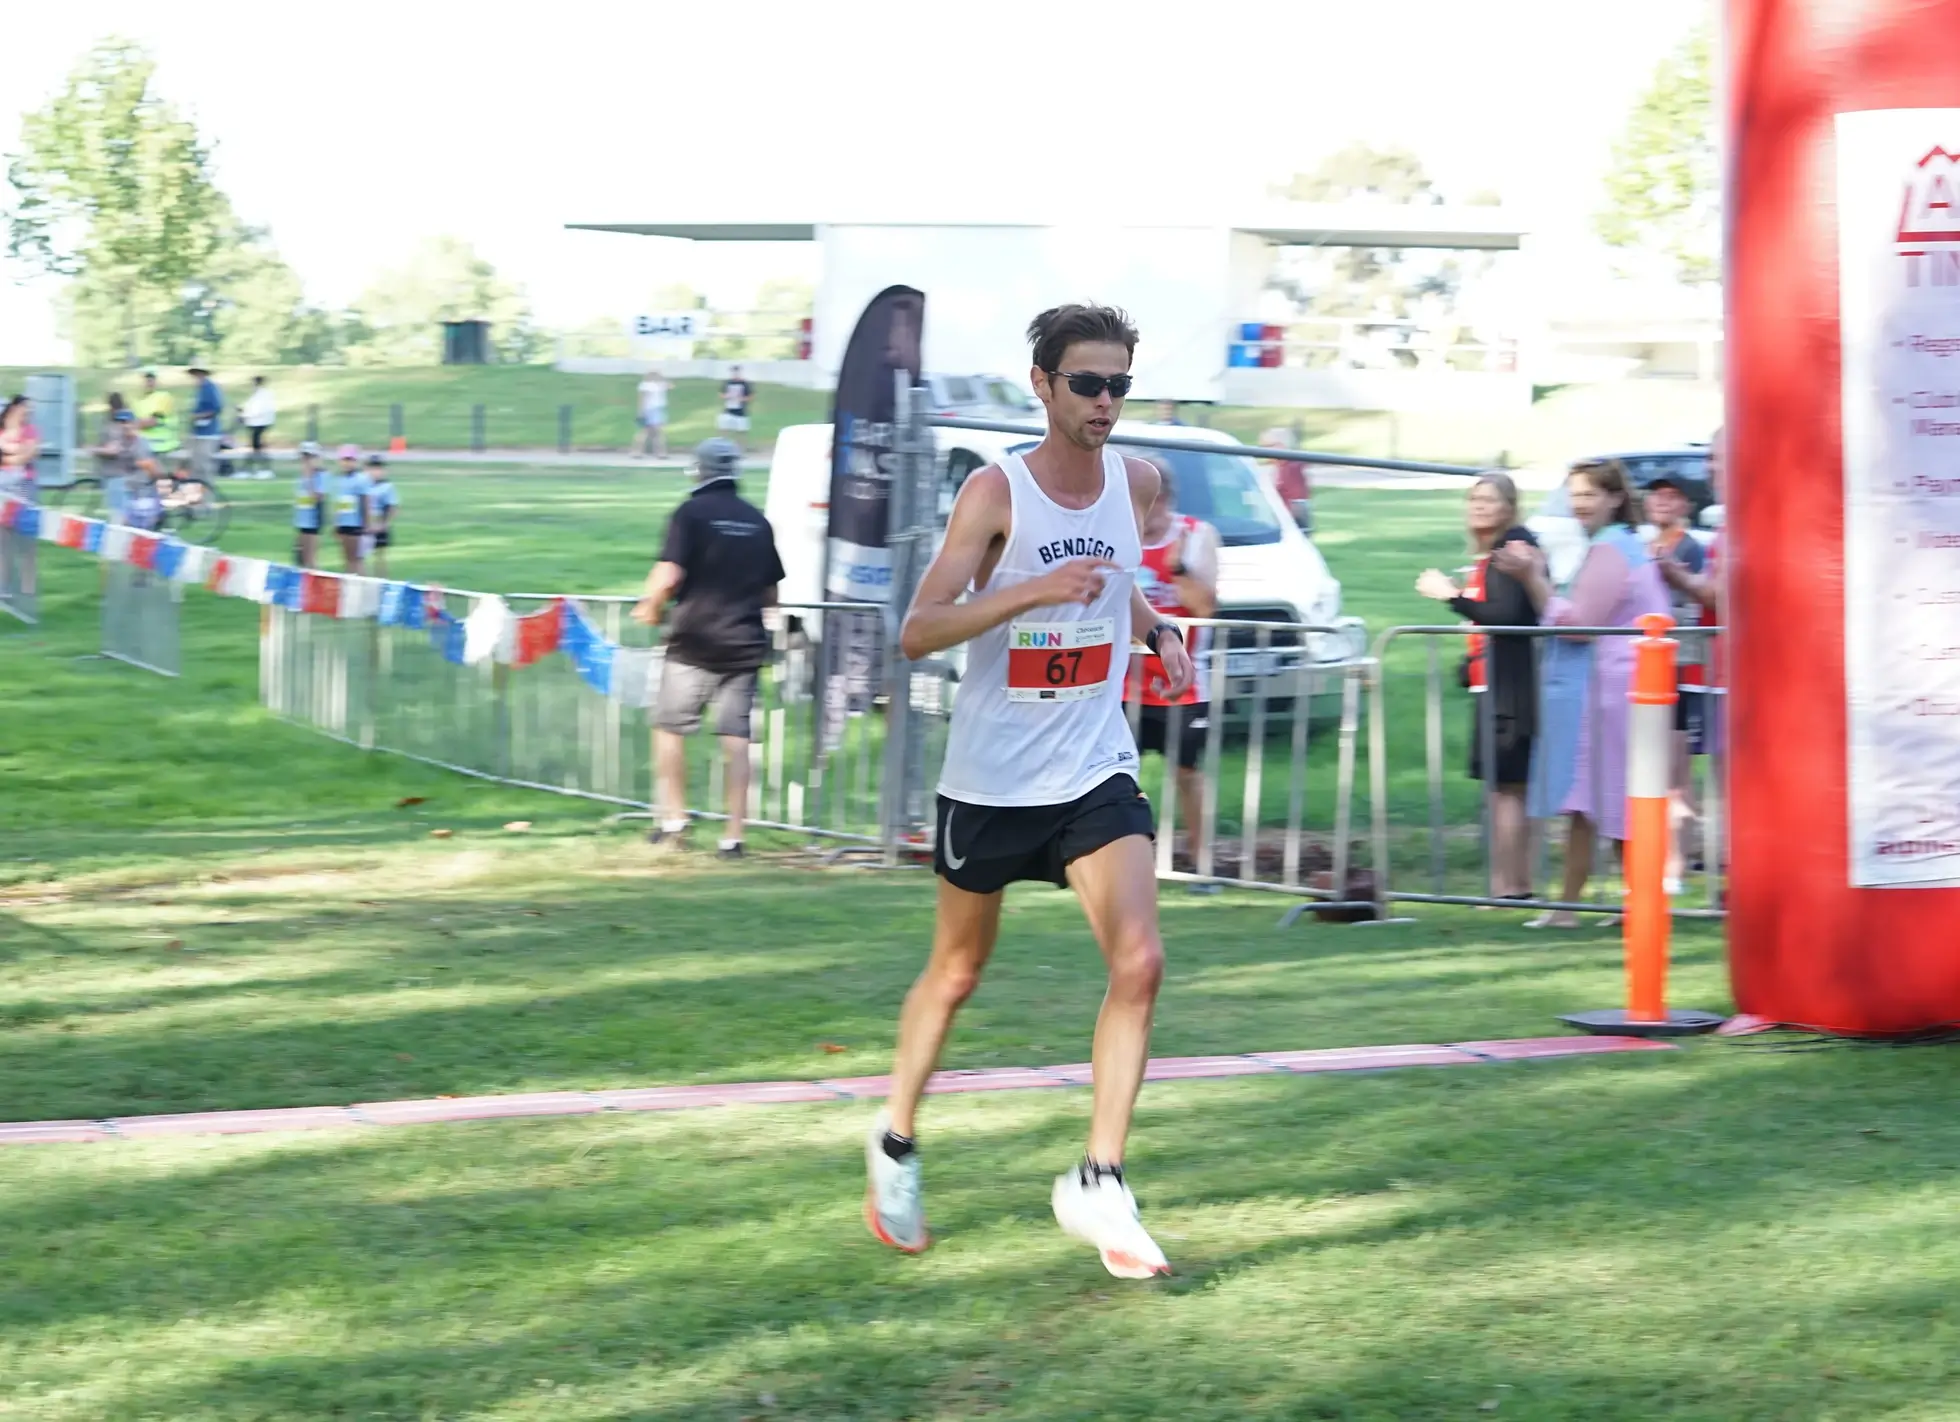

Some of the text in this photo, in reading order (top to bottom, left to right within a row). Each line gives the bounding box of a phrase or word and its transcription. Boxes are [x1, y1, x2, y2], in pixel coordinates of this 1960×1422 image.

[637, 315, 693, 335] BAR
[1038, 537, 1115, 565] BENDIGO
[1018, 631, 1063, 647] RUN
[1046, 651, 1083, 685] 67
